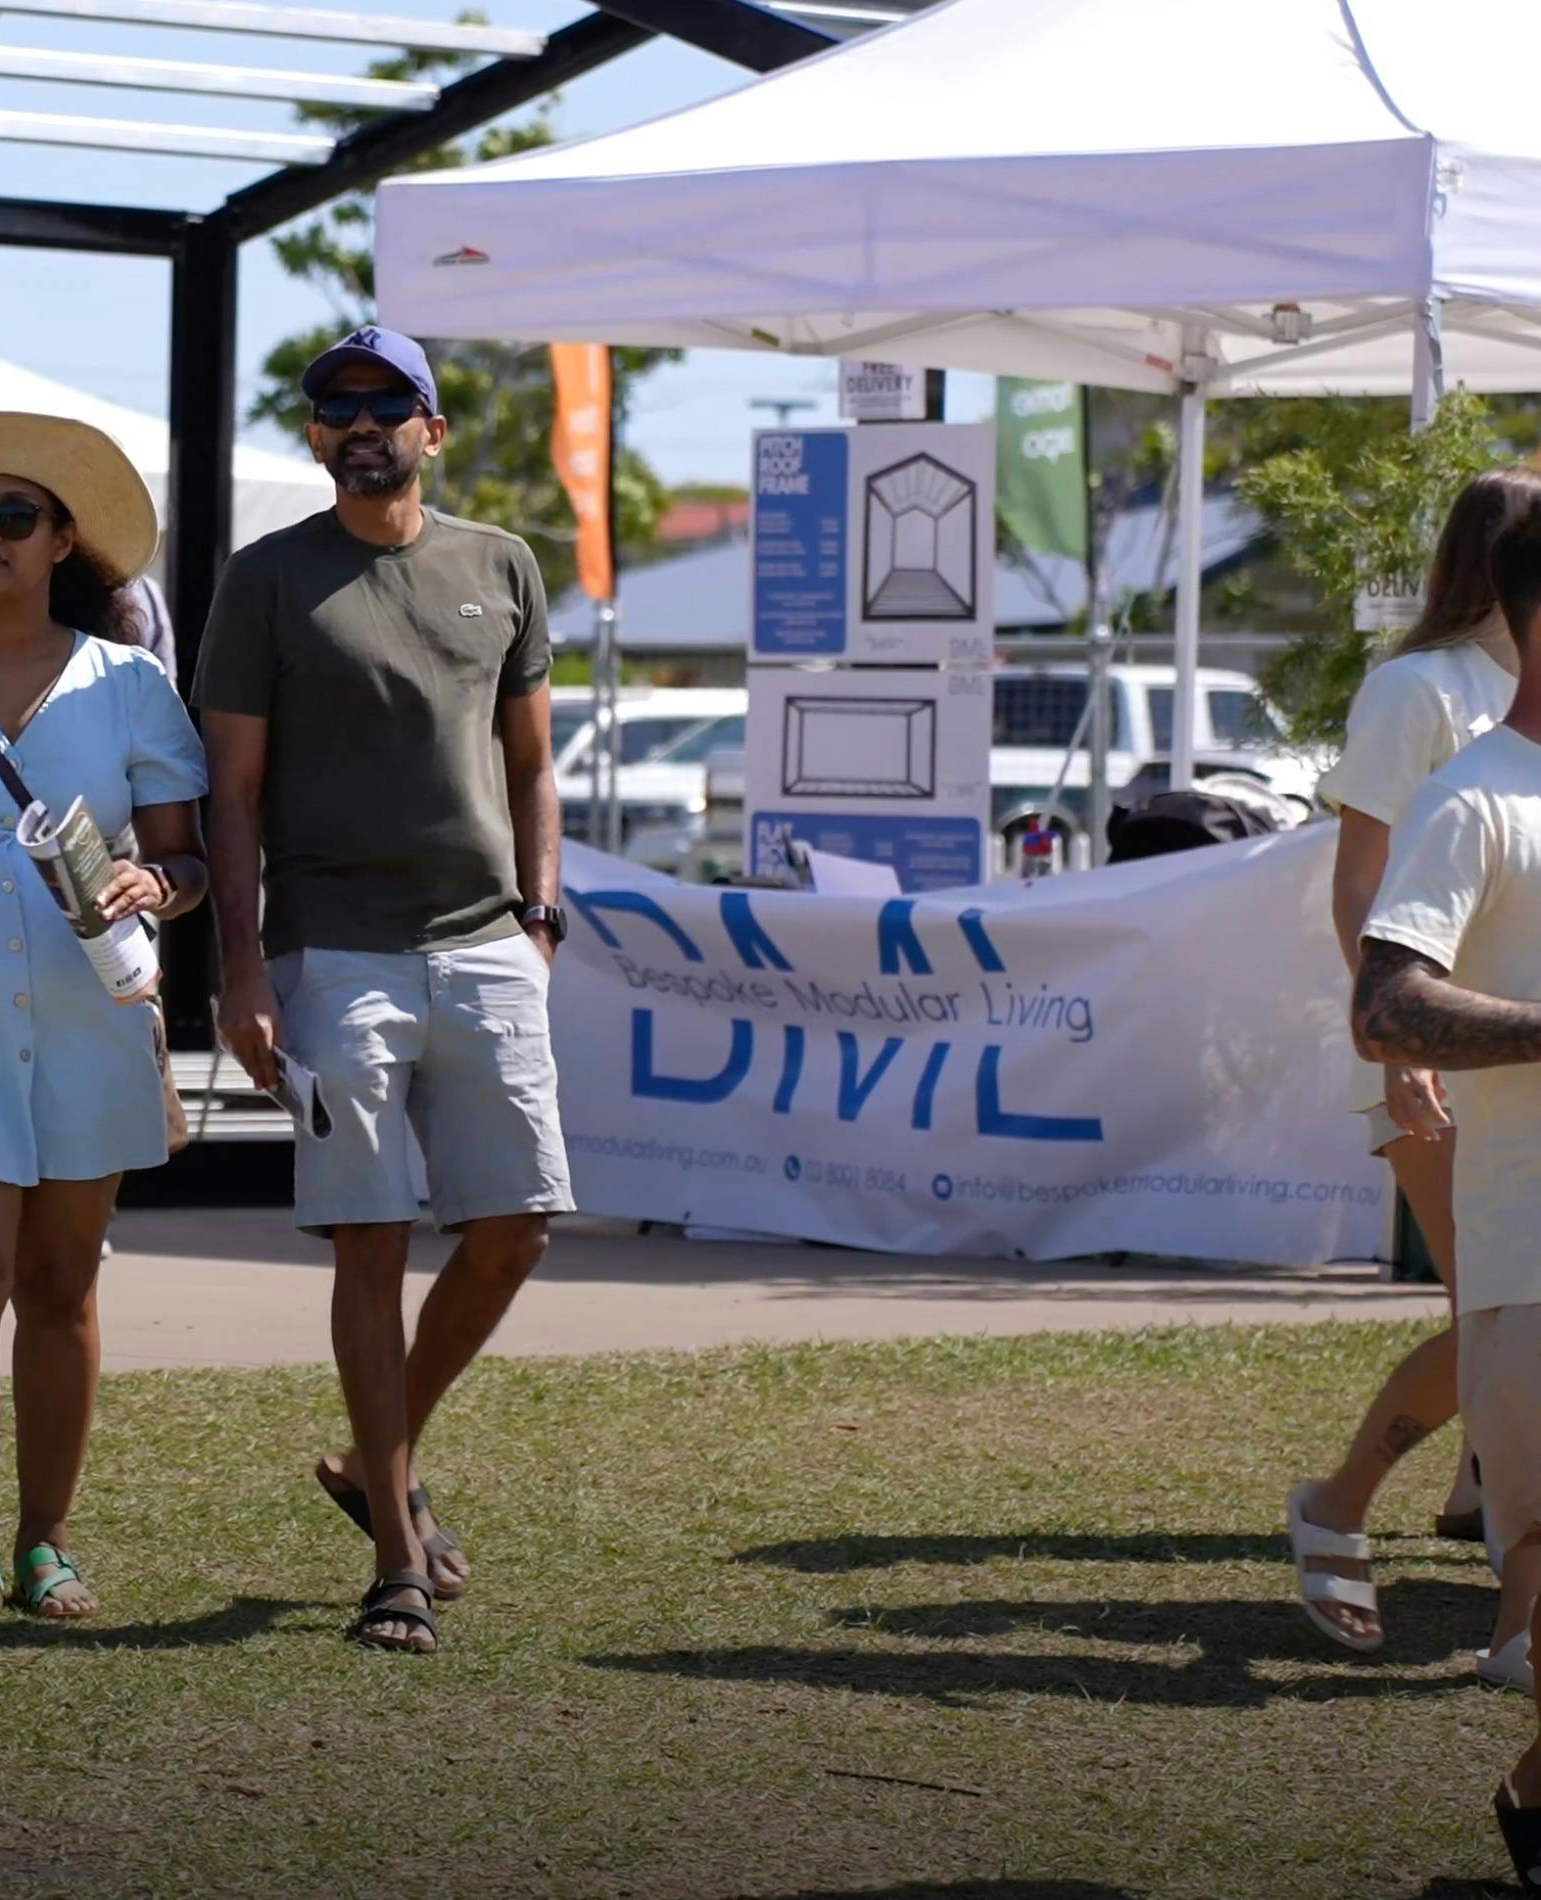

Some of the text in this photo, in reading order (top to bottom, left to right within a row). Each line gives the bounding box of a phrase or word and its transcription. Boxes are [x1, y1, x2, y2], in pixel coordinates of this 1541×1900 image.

[847, 376, 913, 393] DELIVERY
[758, 475, 810, 494] FRAME
[1367, 580, 1420, 597] DELIV
[612, 953, 1094, 1044] Bespoke Modular Living
